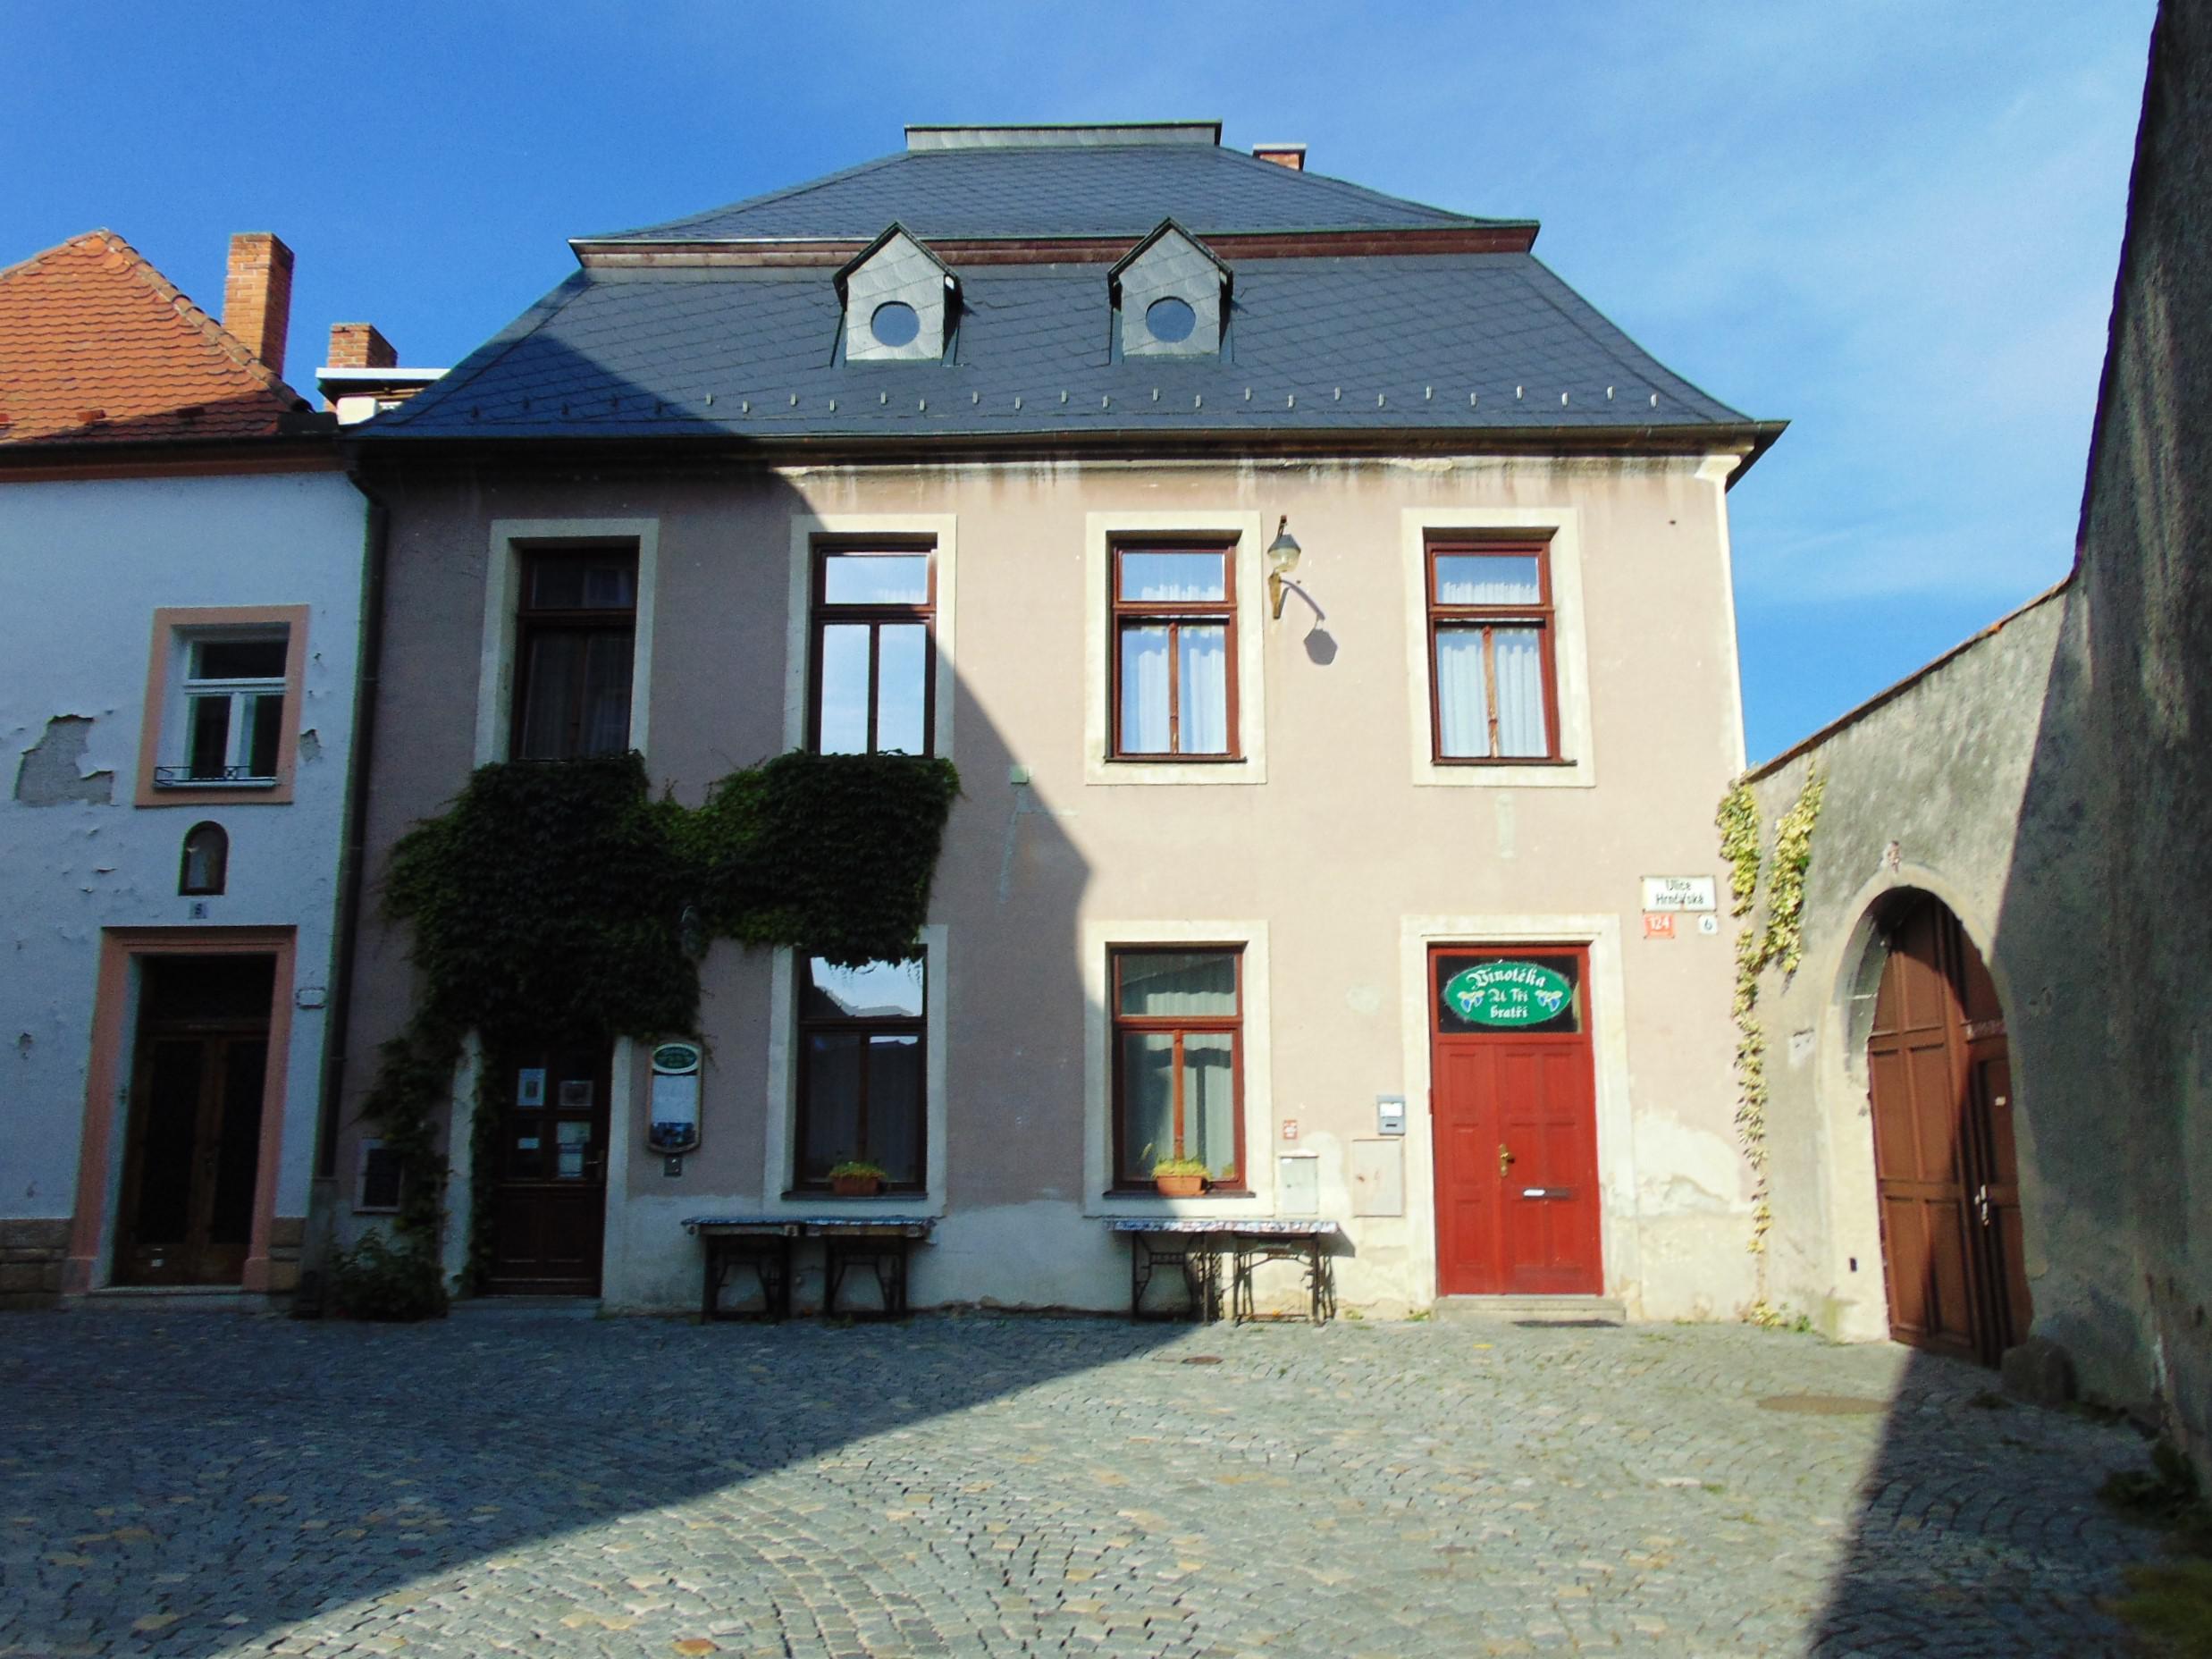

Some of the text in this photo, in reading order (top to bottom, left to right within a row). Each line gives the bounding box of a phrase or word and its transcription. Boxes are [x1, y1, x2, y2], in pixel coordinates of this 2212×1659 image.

[1666, 879, 1692, 891] Ulice
[1647, 914, 1671, 931] 124
[1703, 918, 1713, 931] 6
[1466, 966, 1546, 990] Vinotéka
[1487, 988, 1507, 1003] U
